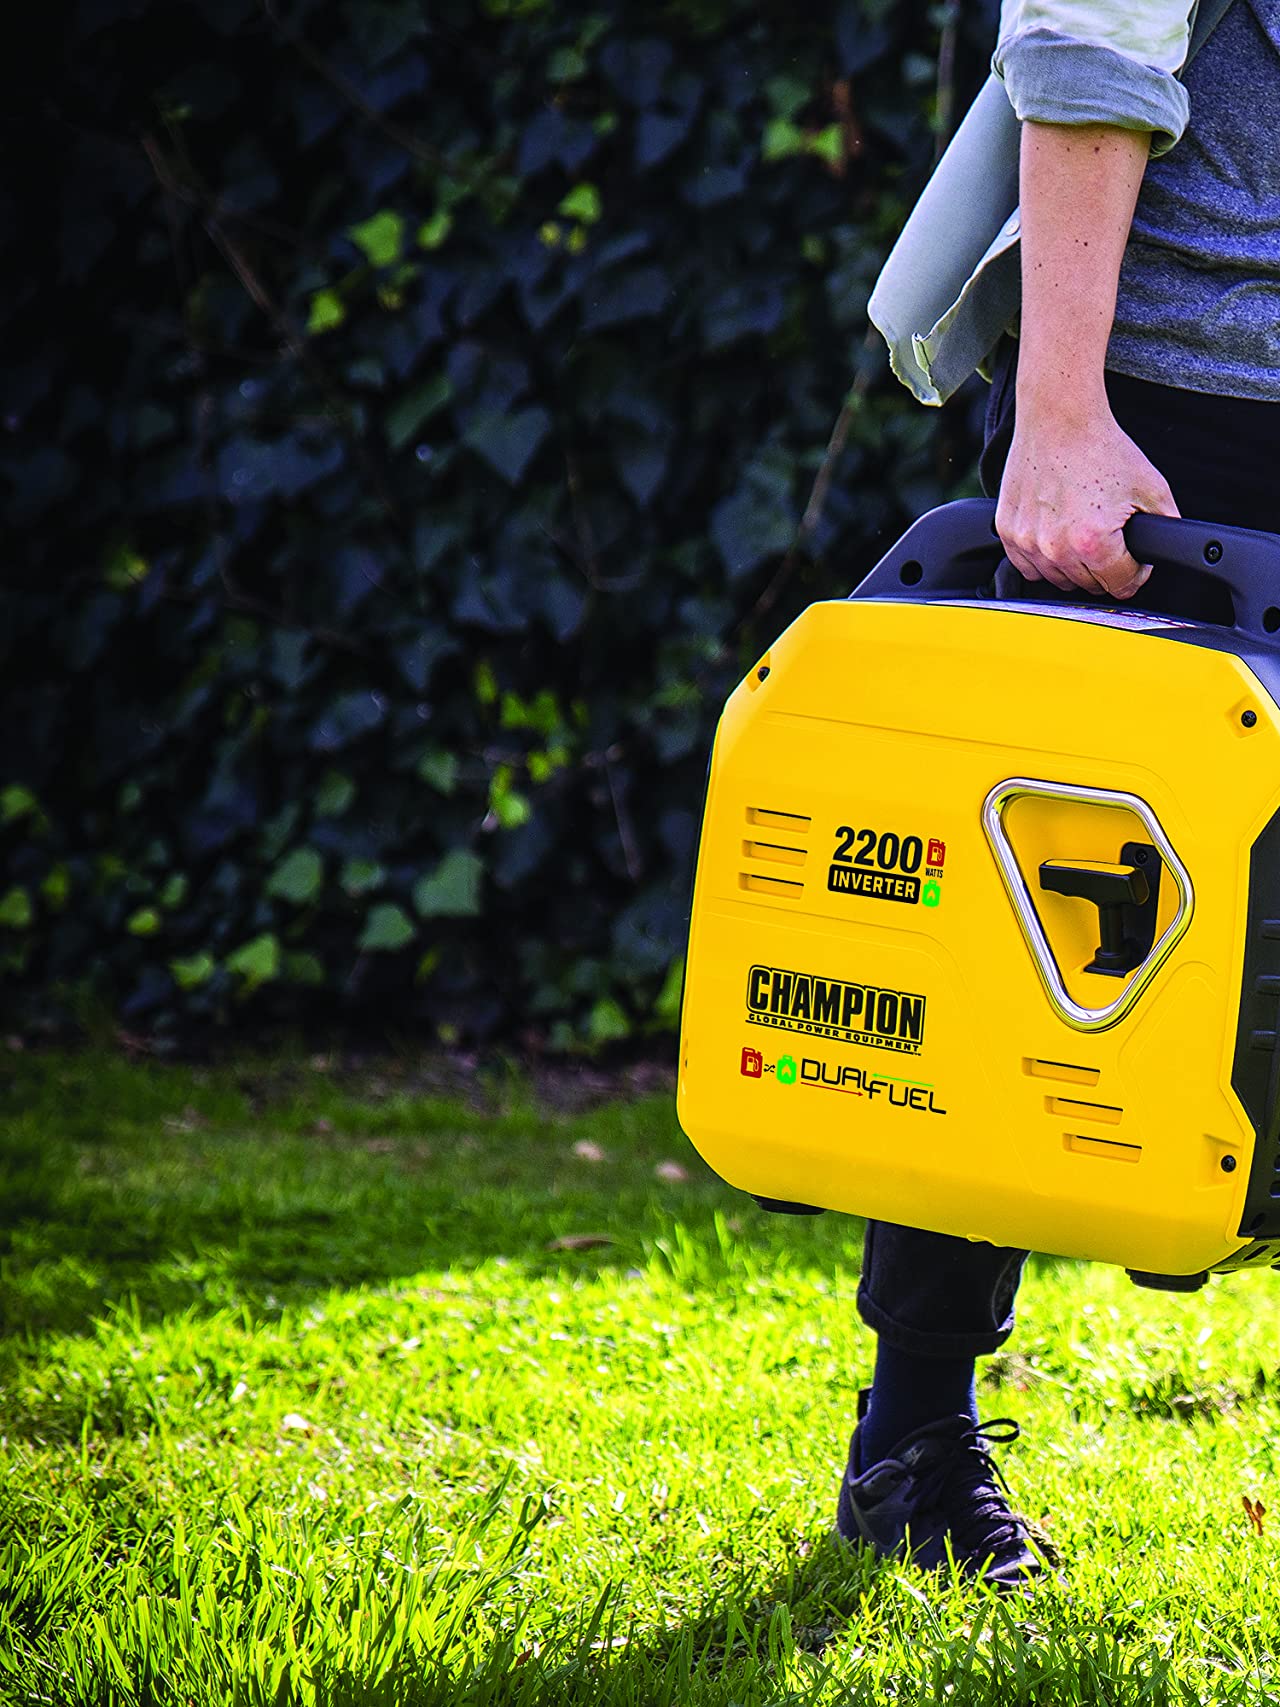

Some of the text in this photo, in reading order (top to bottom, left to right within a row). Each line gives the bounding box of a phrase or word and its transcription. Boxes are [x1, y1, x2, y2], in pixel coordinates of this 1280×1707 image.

[832, 826, 923, 874] 2200
[832, 869, 916, 899] INVERTER
[925, 867, 944, 879] WATTS
[749, 968, 923, 1041] CHAMPION
[748, 1013, 920, 1053] GLOBAL POWER EQUIPMENT
